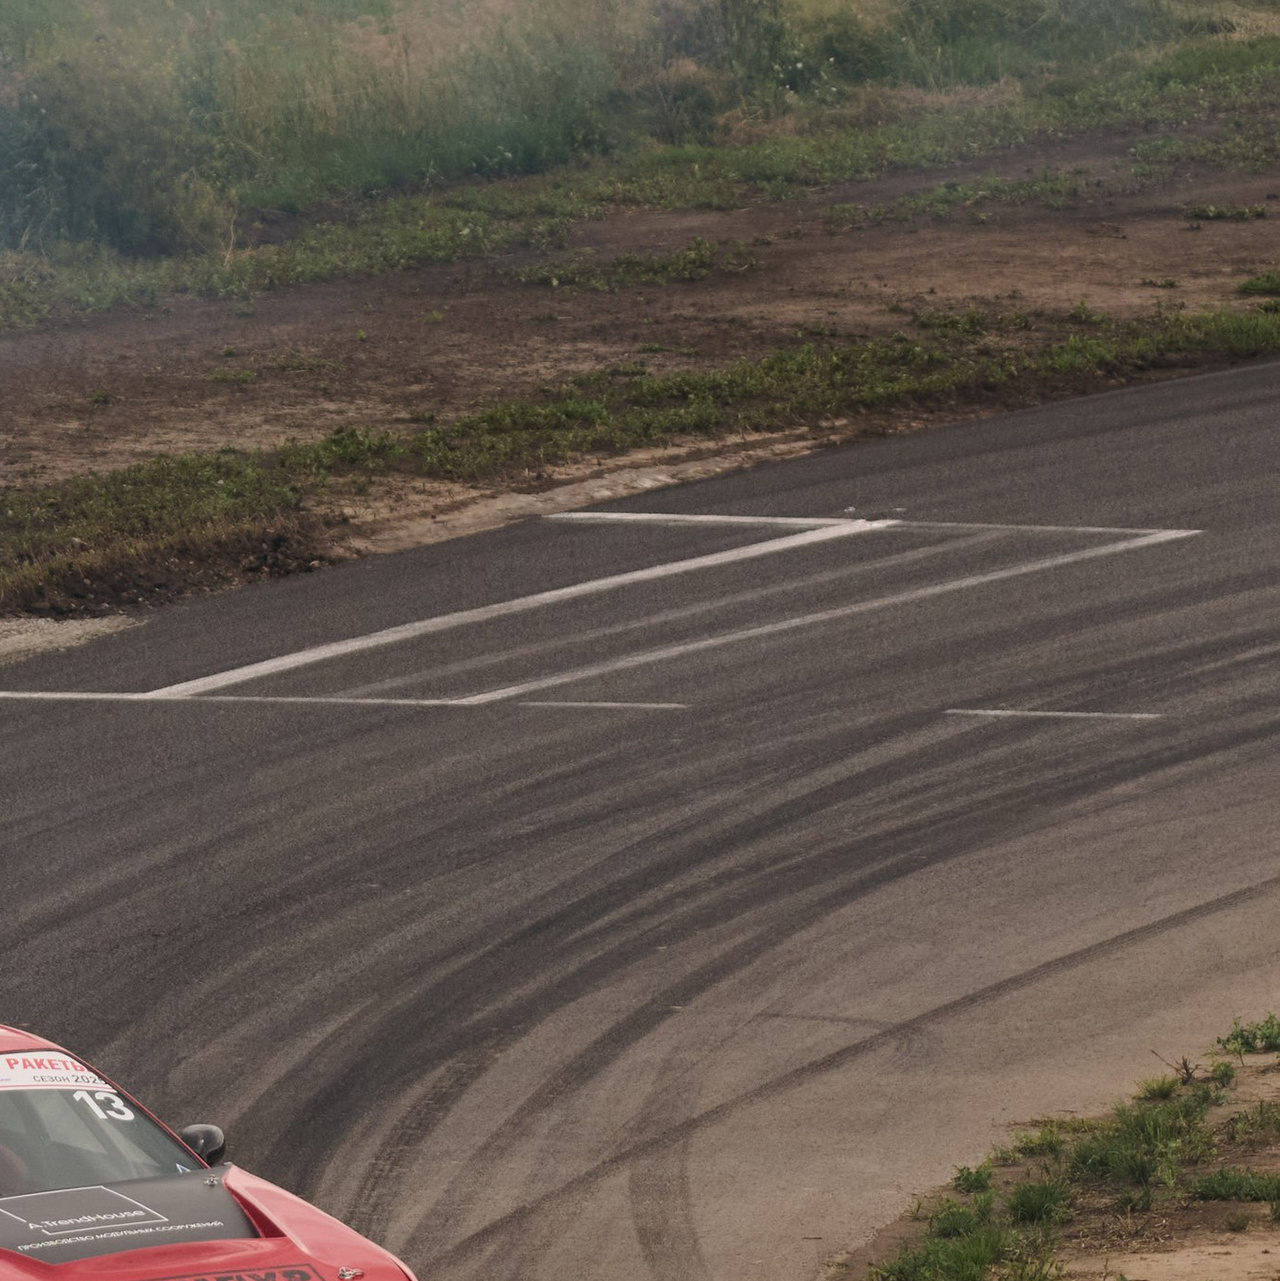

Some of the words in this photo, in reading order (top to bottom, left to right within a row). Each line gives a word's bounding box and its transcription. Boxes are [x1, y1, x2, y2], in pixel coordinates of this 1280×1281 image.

[32, 1075, 70, 1084] СЕЗОН
[73, 1090, 135, 1121] 13
[27, 1208, 146, 1230] A.TrendHouse
